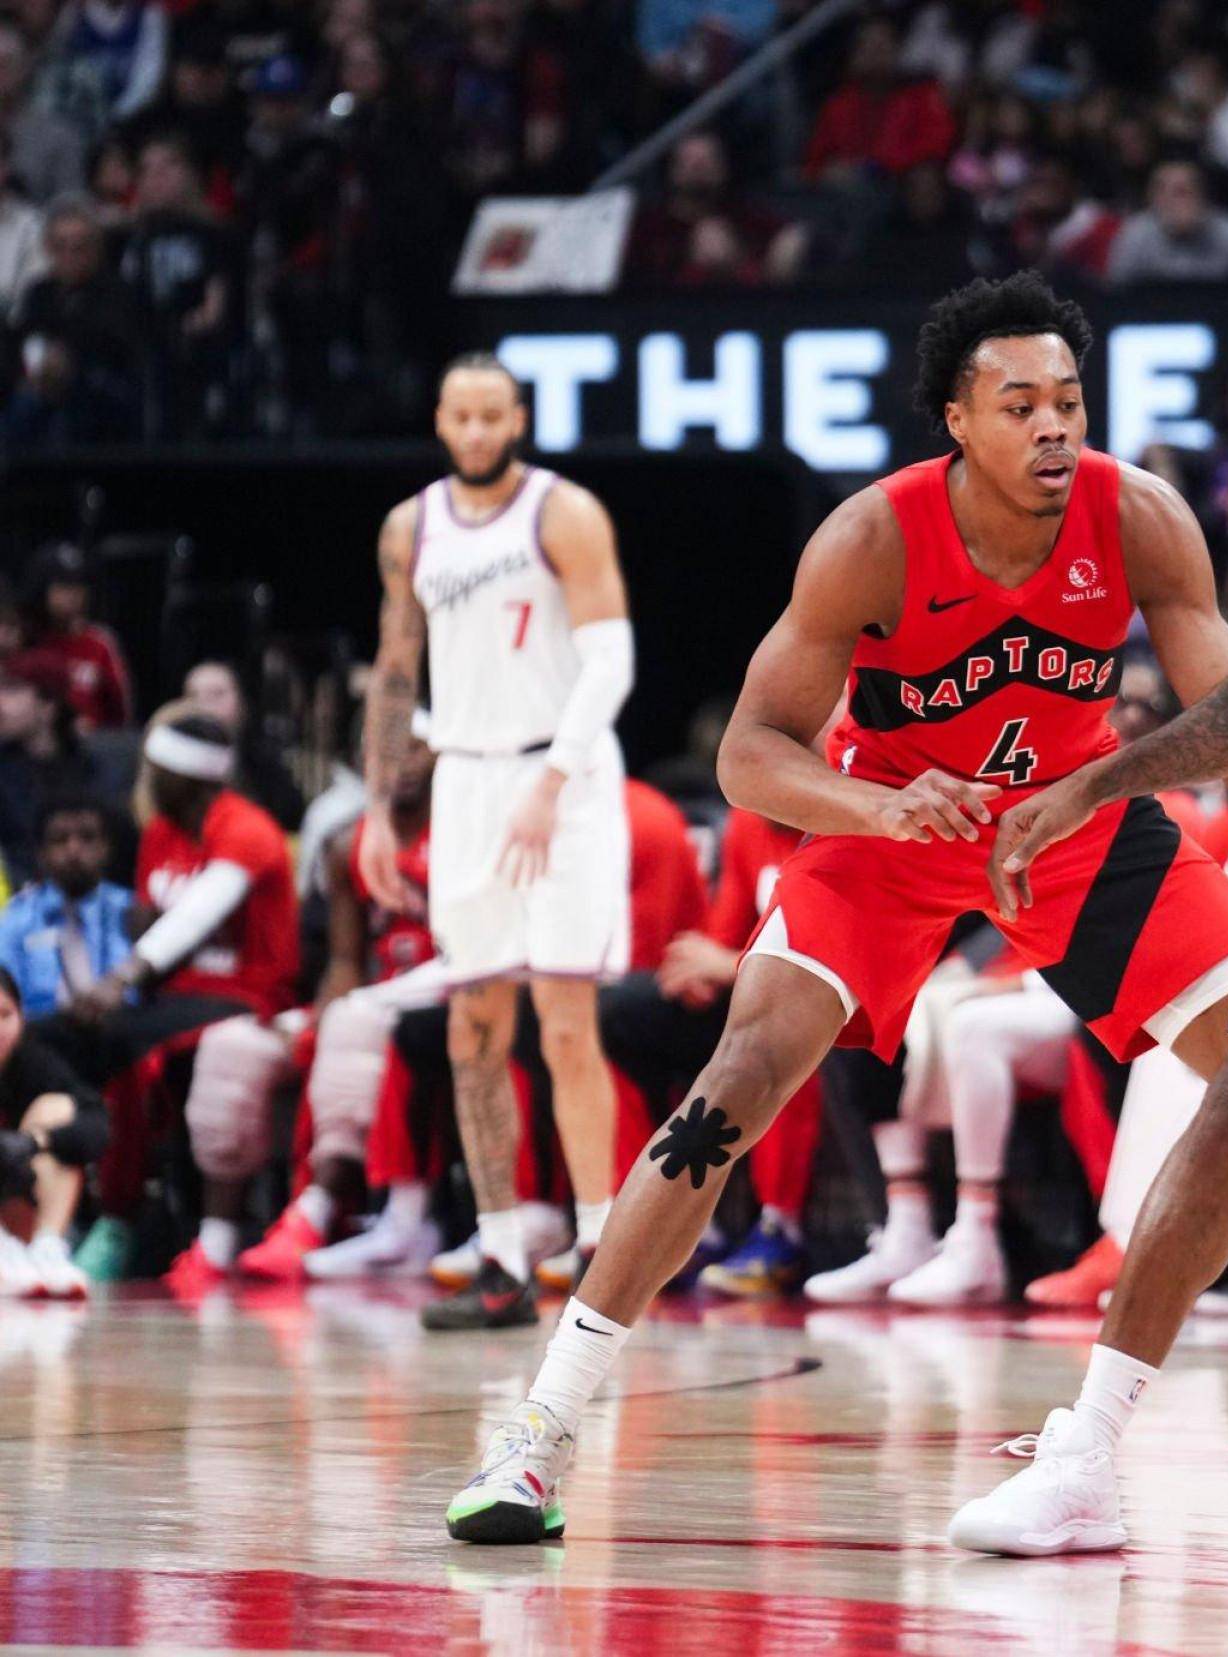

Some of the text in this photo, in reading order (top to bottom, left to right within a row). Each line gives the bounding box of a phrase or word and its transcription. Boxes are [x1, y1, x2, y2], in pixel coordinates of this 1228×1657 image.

[498, 328, 890, 472] THE
[503, 600, 533, 651] 7
[1062, 587, 1107, 602] Sun Life
[901, 636, 1115, 718] RAPTORS
[974, 716, 1038, 786] 4
